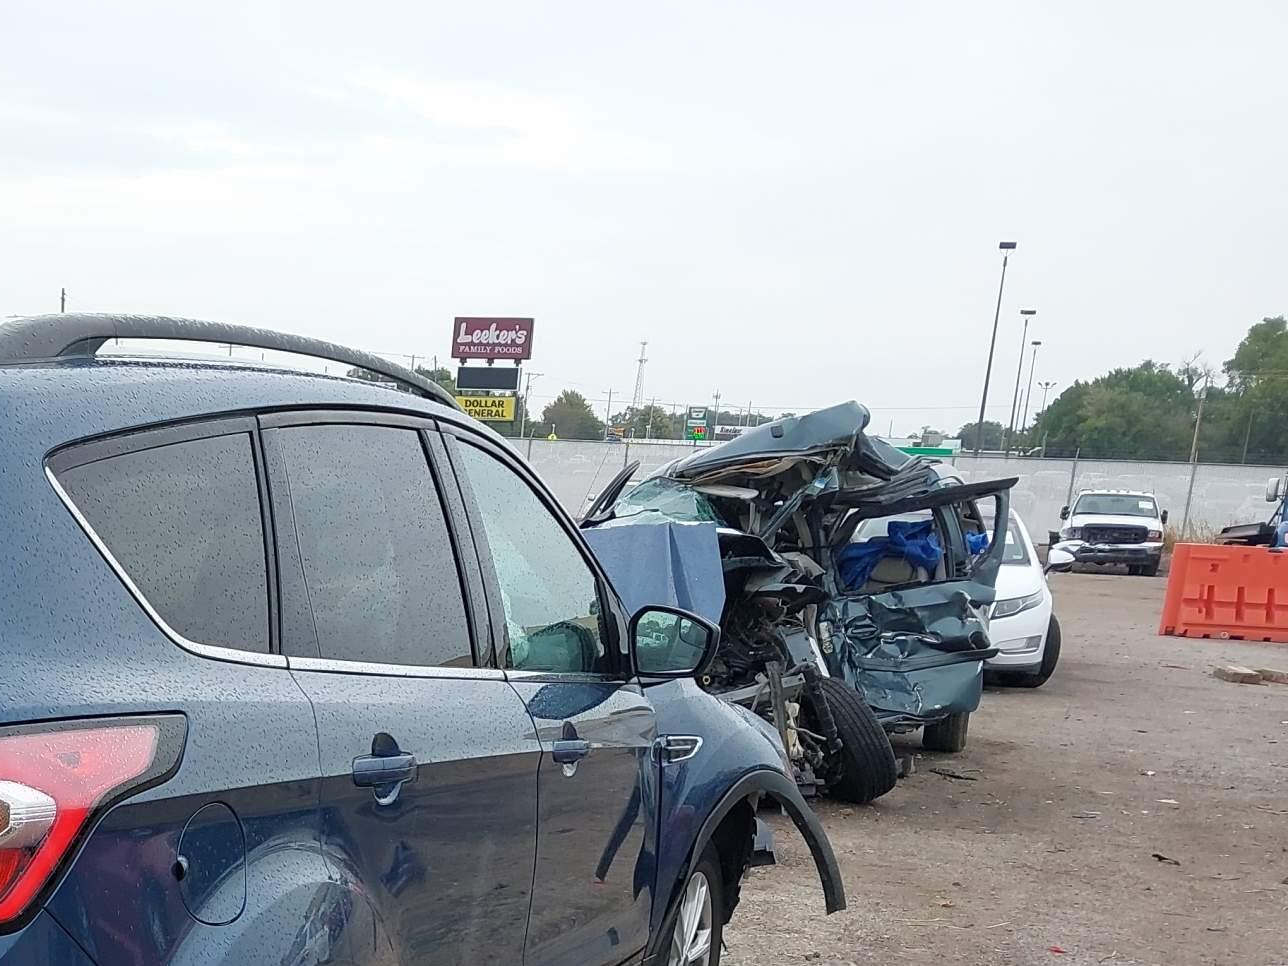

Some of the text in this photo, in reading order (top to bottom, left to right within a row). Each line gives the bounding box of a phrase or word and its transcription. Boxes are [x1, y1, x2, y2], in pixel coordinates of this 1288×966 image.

[457, 322, 528, 345] Leeker's
[459, 345, 523, 354] FAMILY FOODS
[464, 399, 505, 408] DOLLAR
